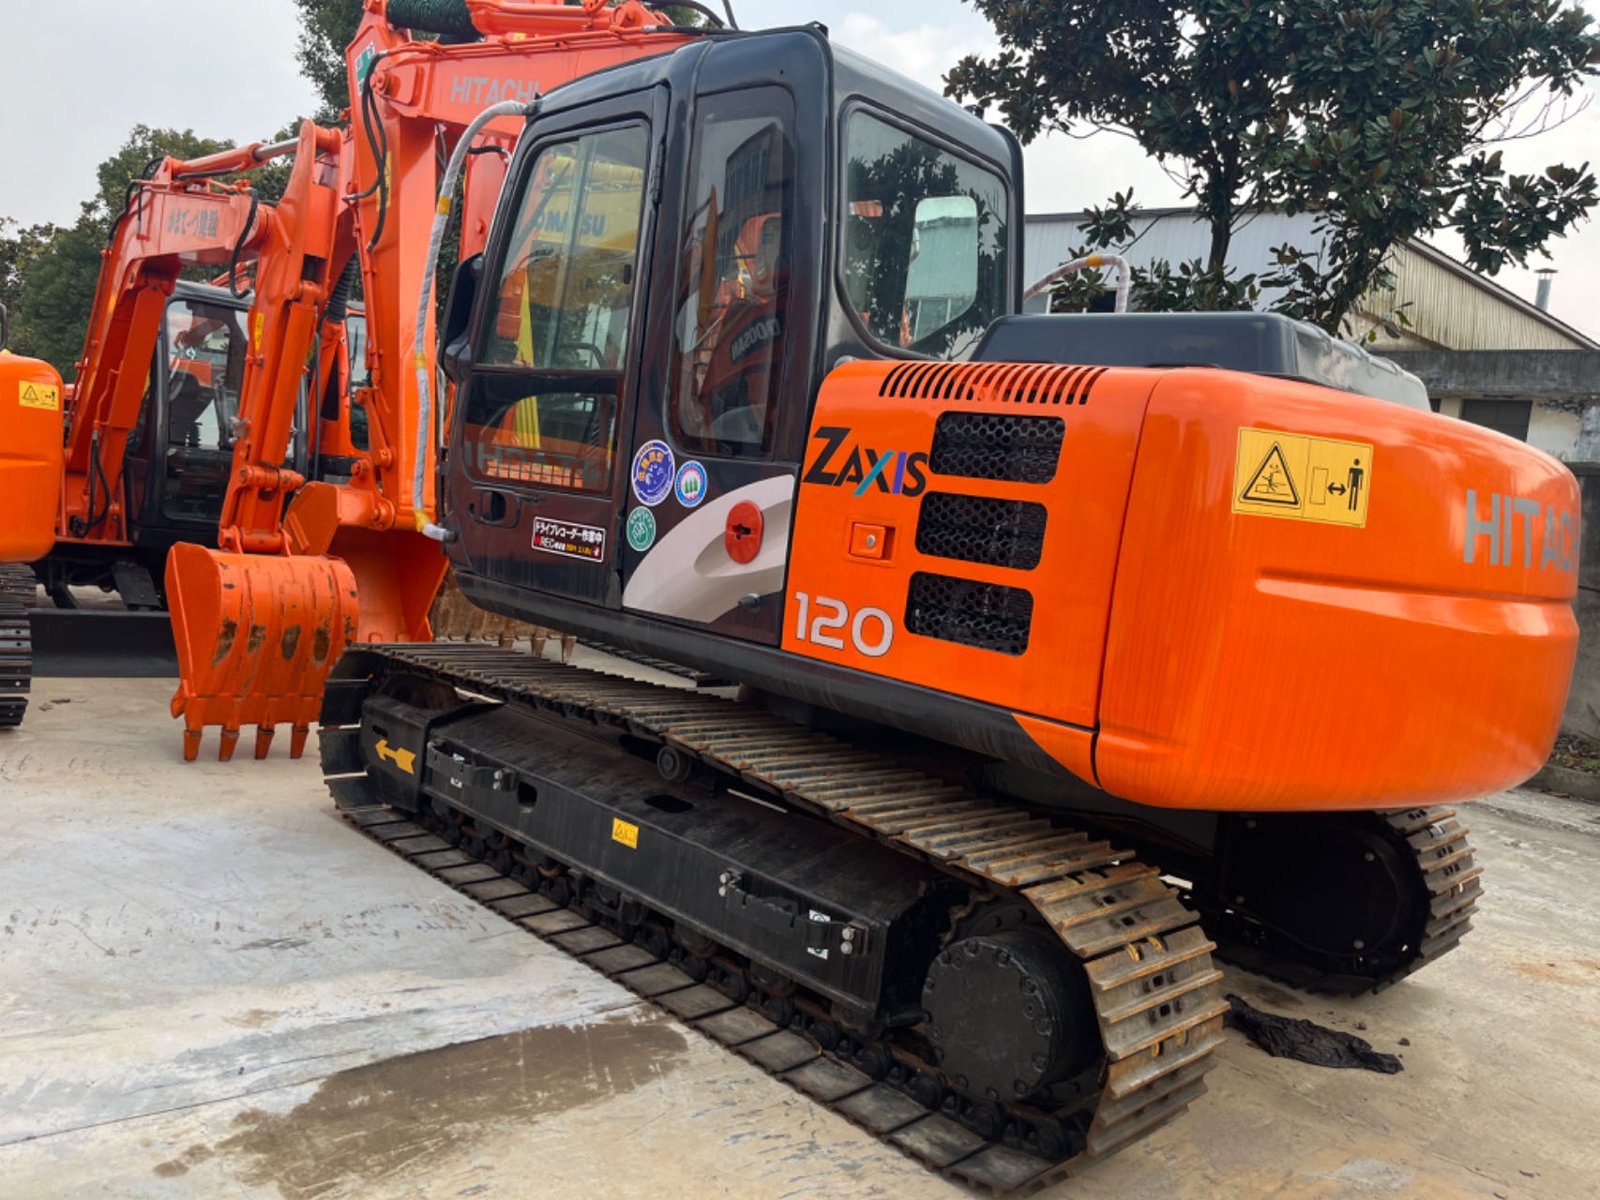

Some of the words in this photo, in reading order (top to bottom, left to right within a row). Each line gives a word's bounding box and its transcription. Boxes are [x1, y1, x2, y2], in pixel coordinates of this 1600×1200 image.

[450, 76, 540, 106] HITACHI
[803, 426, 928, 497] ZAXIS
[795, 592, 894, 657] 120
